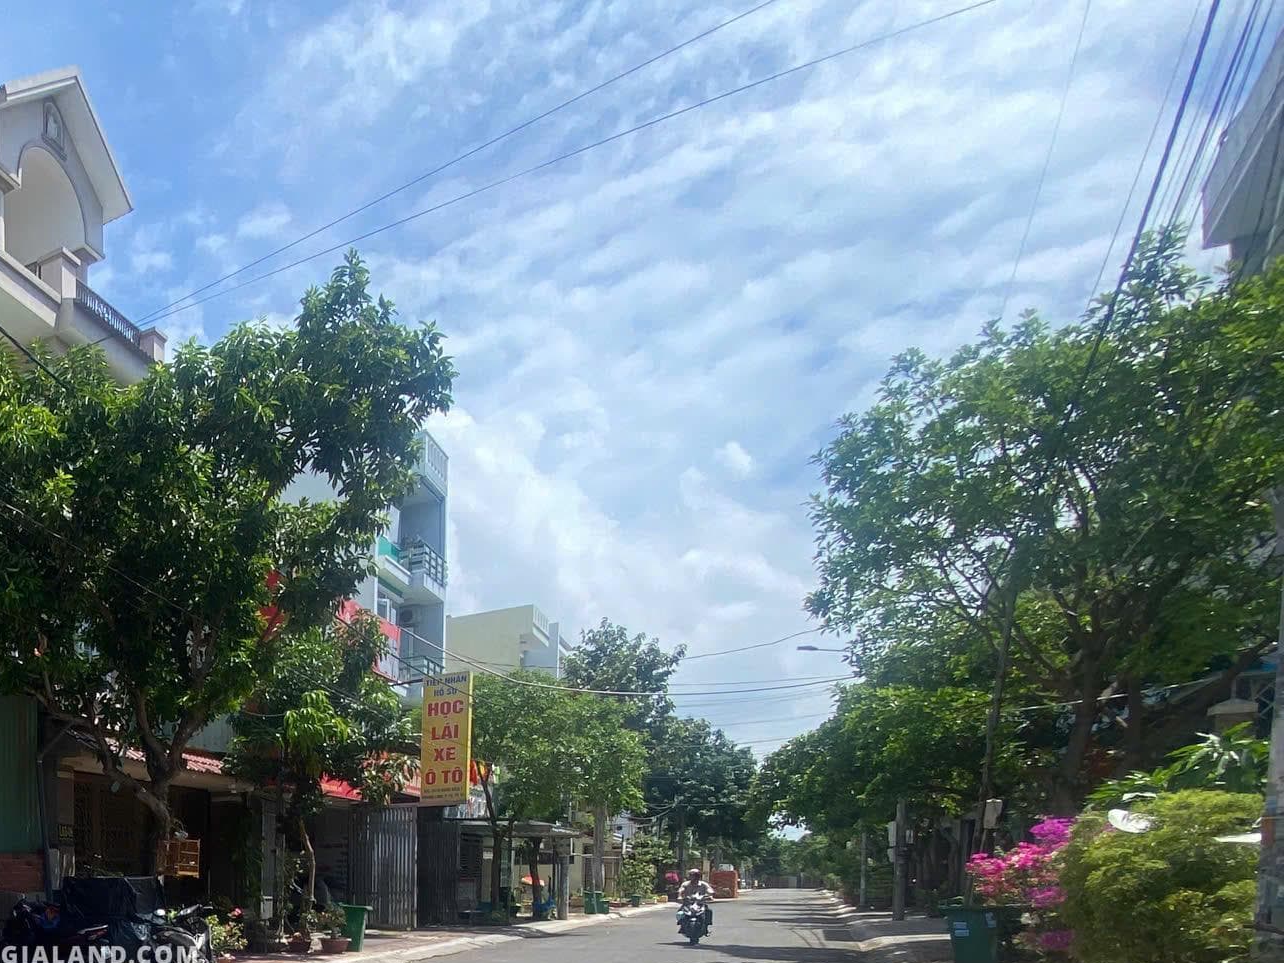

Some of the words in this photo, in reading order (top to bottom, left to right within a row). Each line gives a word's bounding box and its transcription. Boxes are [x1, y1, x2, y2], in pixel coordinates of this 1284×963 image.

[427, 699, 464, 719] HỌC
[431, 722, 459, 741] LÁI
[433, 747, 456, 762] XE
[424, 768, 436, 785] Ô
[441, 766, 463, 784] TÔ
